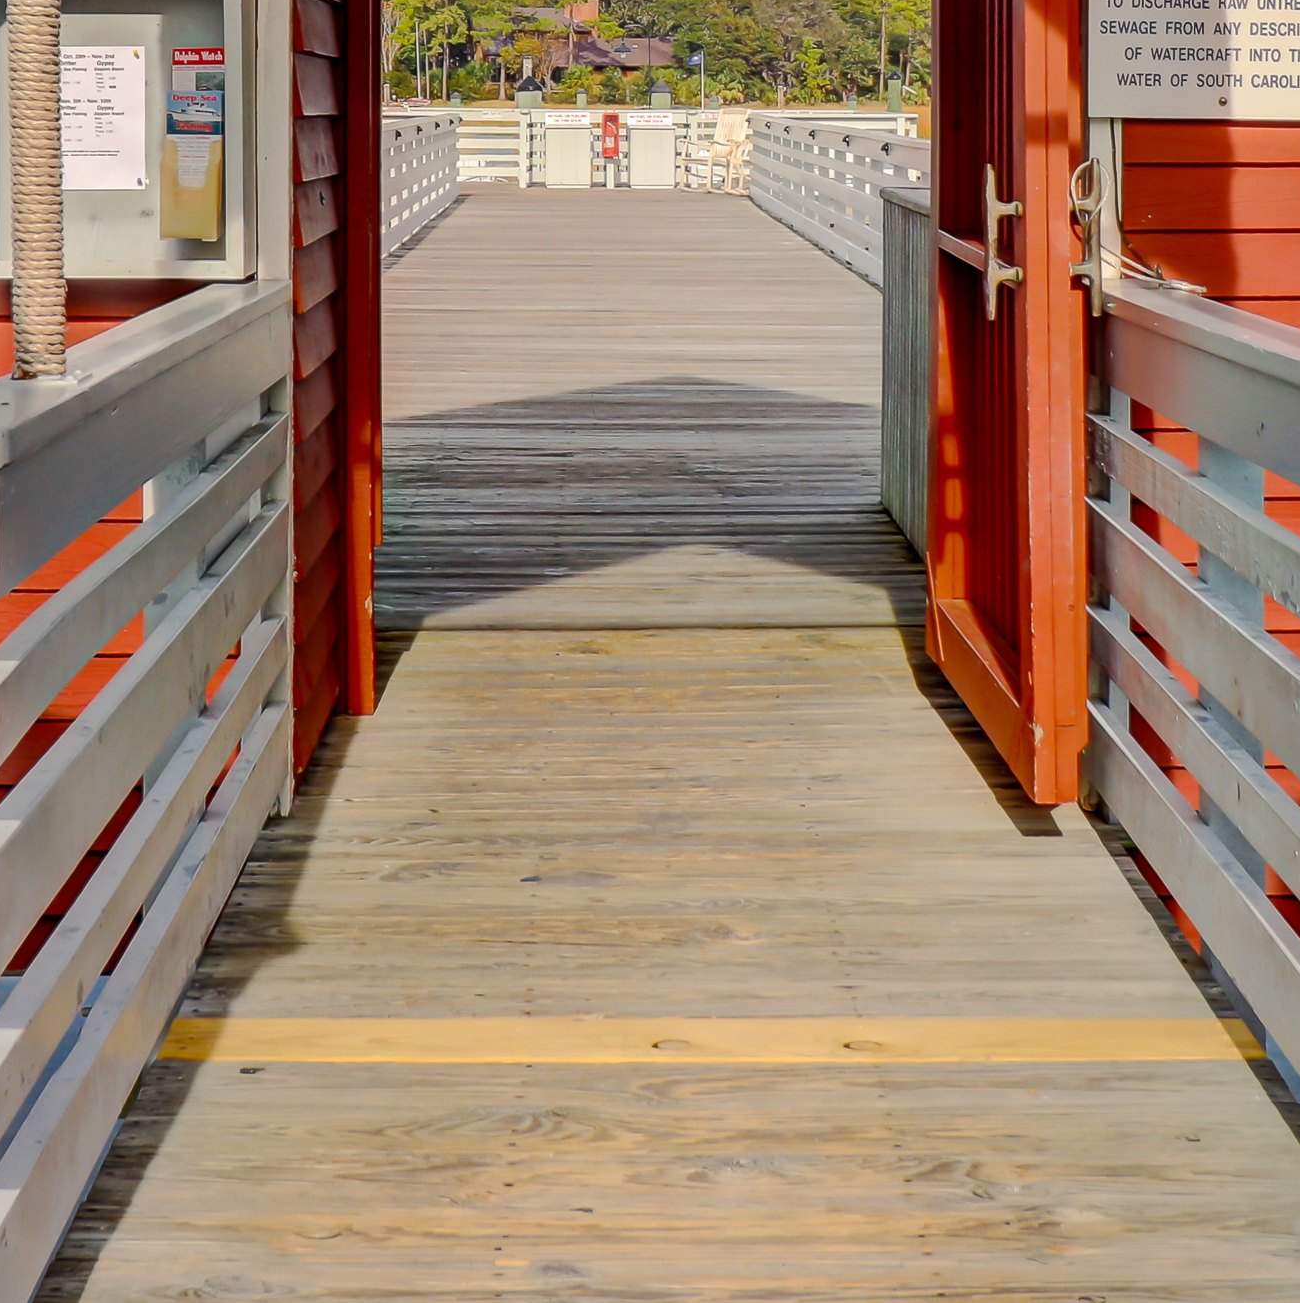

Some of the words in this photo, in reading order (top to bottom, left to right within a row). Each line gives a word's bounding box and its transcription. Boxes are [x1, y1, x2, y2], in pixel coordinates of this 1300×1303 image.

[1100, 21, 1157, 35] SEWAGE
[1166, 22, 1204, 35] FROM
[1214, 22, 1240, 36] ANY
[175, 51, 199, 63] Dolphin
[201, 51, 222, 60] Watch
[1124, 47, 1142, 60] OF
[1151, 48, 1241, 62] WATERCRAFT
[1249, 48, 1281, 62] INTO
[1117, 73, 1162, 86] WATER
[1170, 74, 1188, 87] OF
[1196, 74, 1242, 88] SOUTH
[173, 94, 197, 103] Deep
